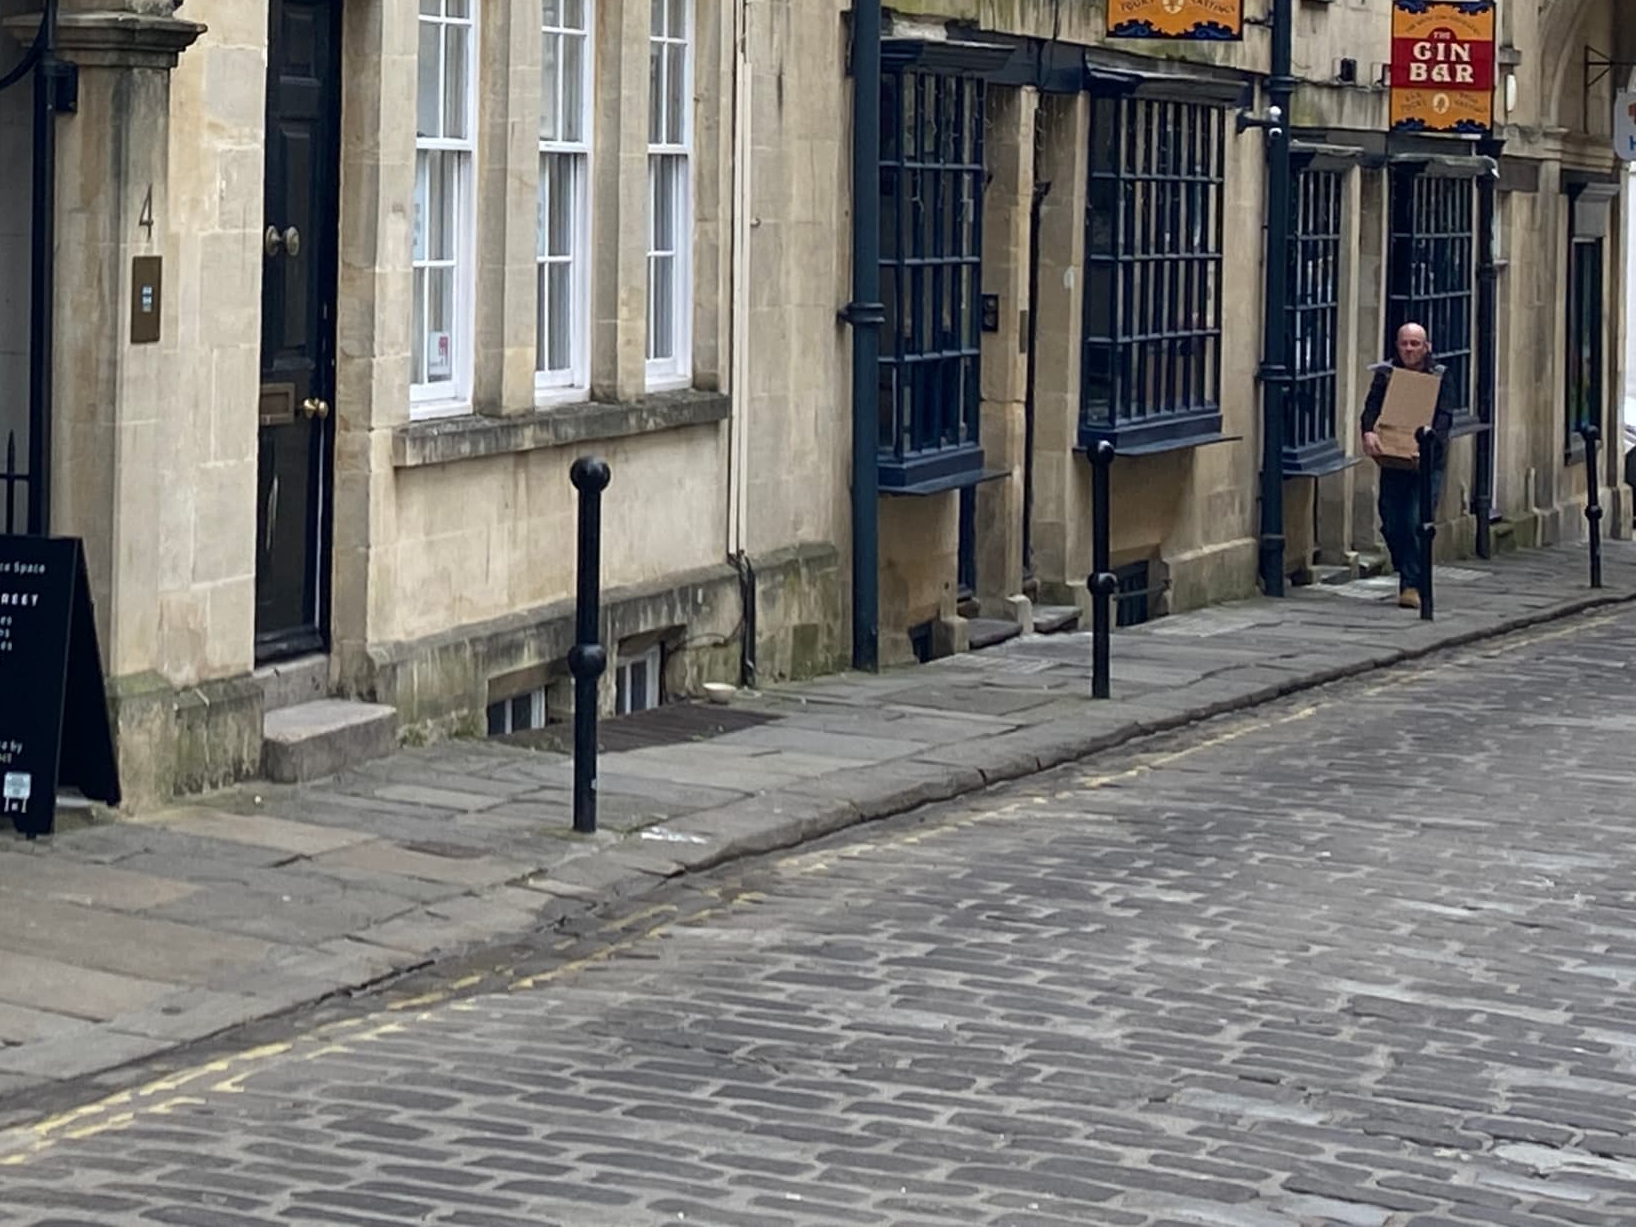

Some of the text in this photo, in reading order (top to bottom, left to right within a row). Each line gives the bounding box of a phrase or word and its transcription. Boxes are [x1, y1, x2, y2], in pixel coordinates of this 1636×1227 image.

[1413, 41, 1470, 61] GIN
[1409, 63, 1474, 83] BAR
[139, 183, 154, 243] 4
[13, 561, 46, 575] Space
